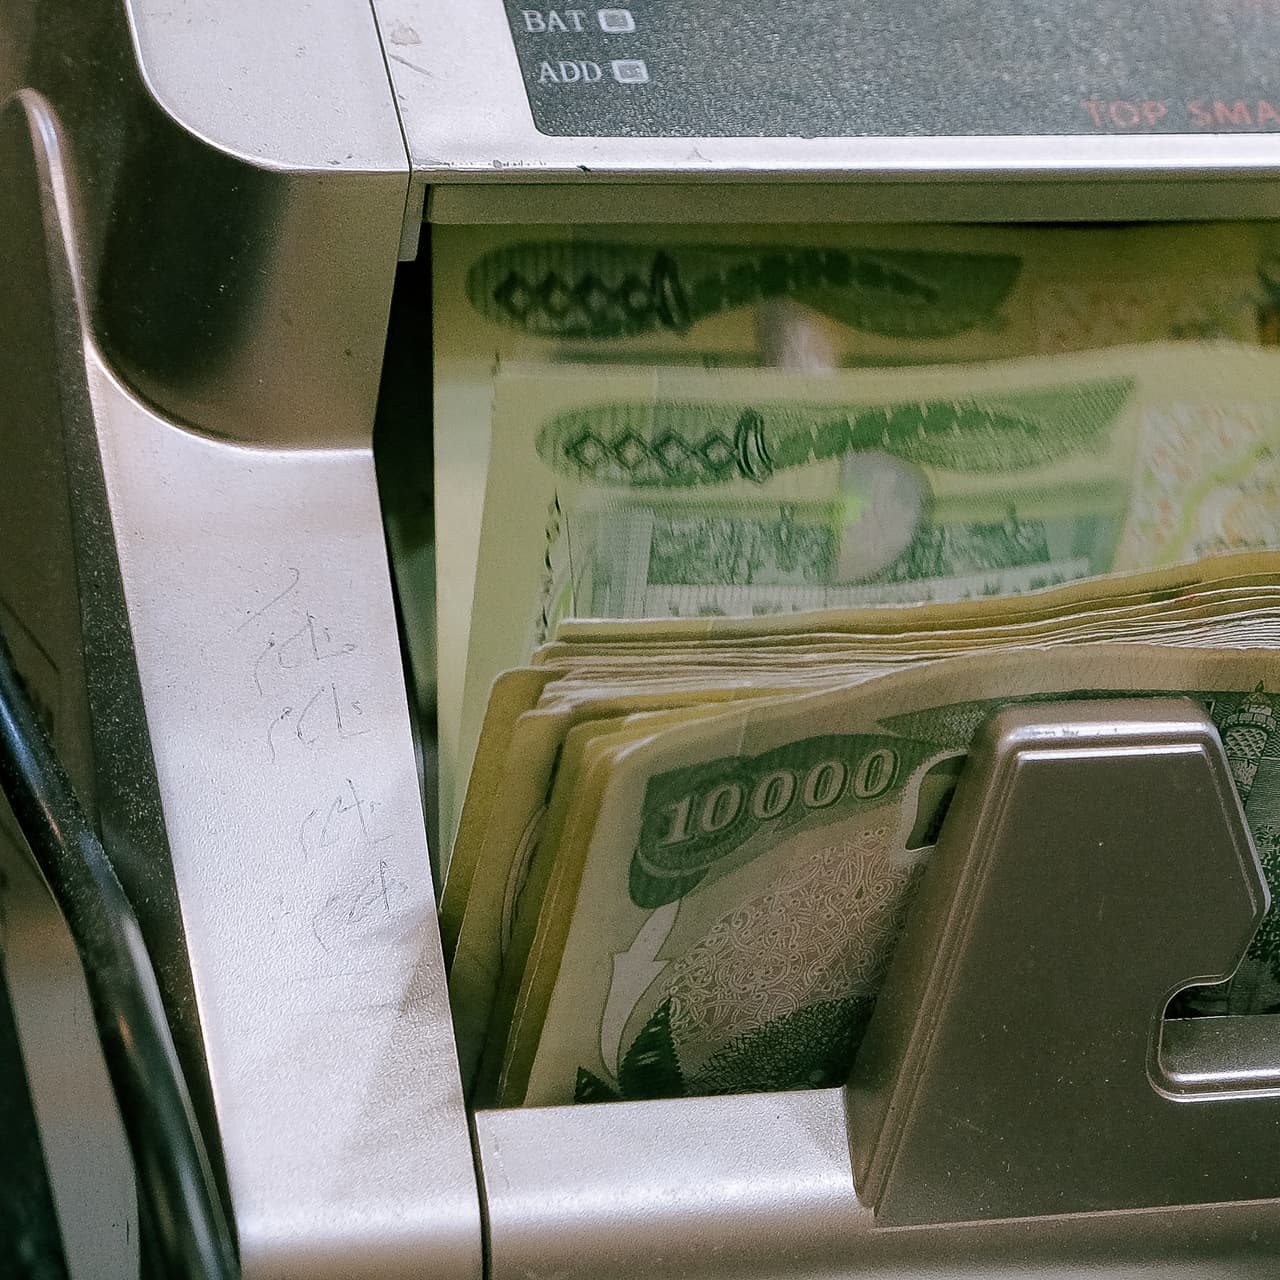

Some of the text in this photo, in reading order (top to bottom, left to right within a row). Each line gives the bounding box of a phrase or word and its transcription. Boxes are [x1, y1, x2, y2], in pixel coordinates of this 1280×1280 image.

[522, 9, 586, 33] BAT
[537, 60, 601, 84] ADD
[1080, 98, 1168, 127] TOP
[657, 748, 900, 849] 10000
